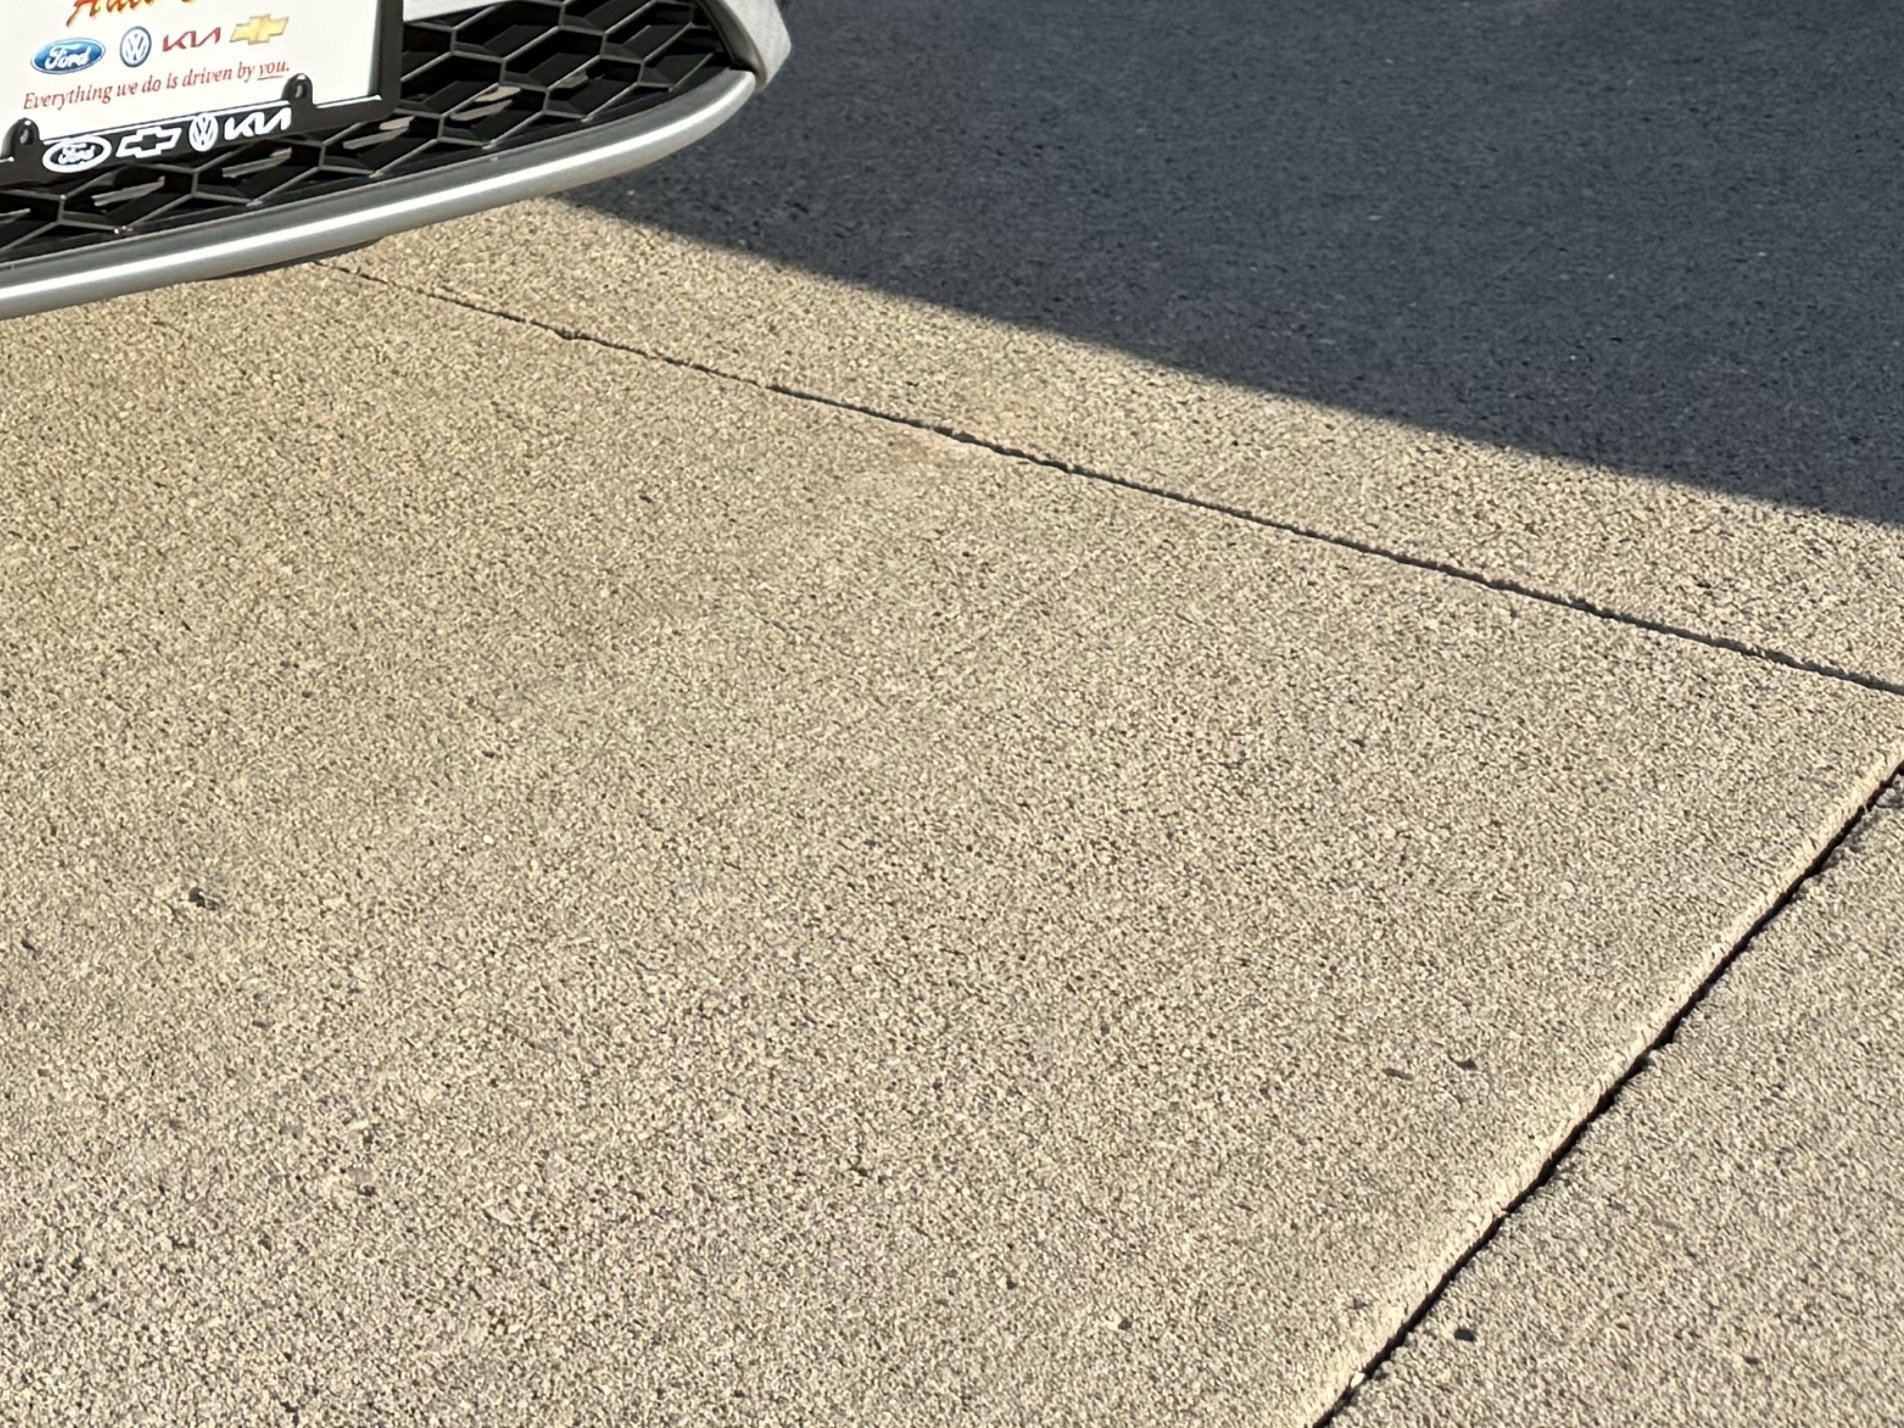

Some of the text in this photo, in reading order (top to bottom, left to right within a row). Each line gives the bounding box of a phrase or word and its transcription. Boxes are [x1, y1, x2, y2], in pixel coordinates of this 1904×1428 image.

[23, 61, 291, 111] Everything we do is driven by you.
